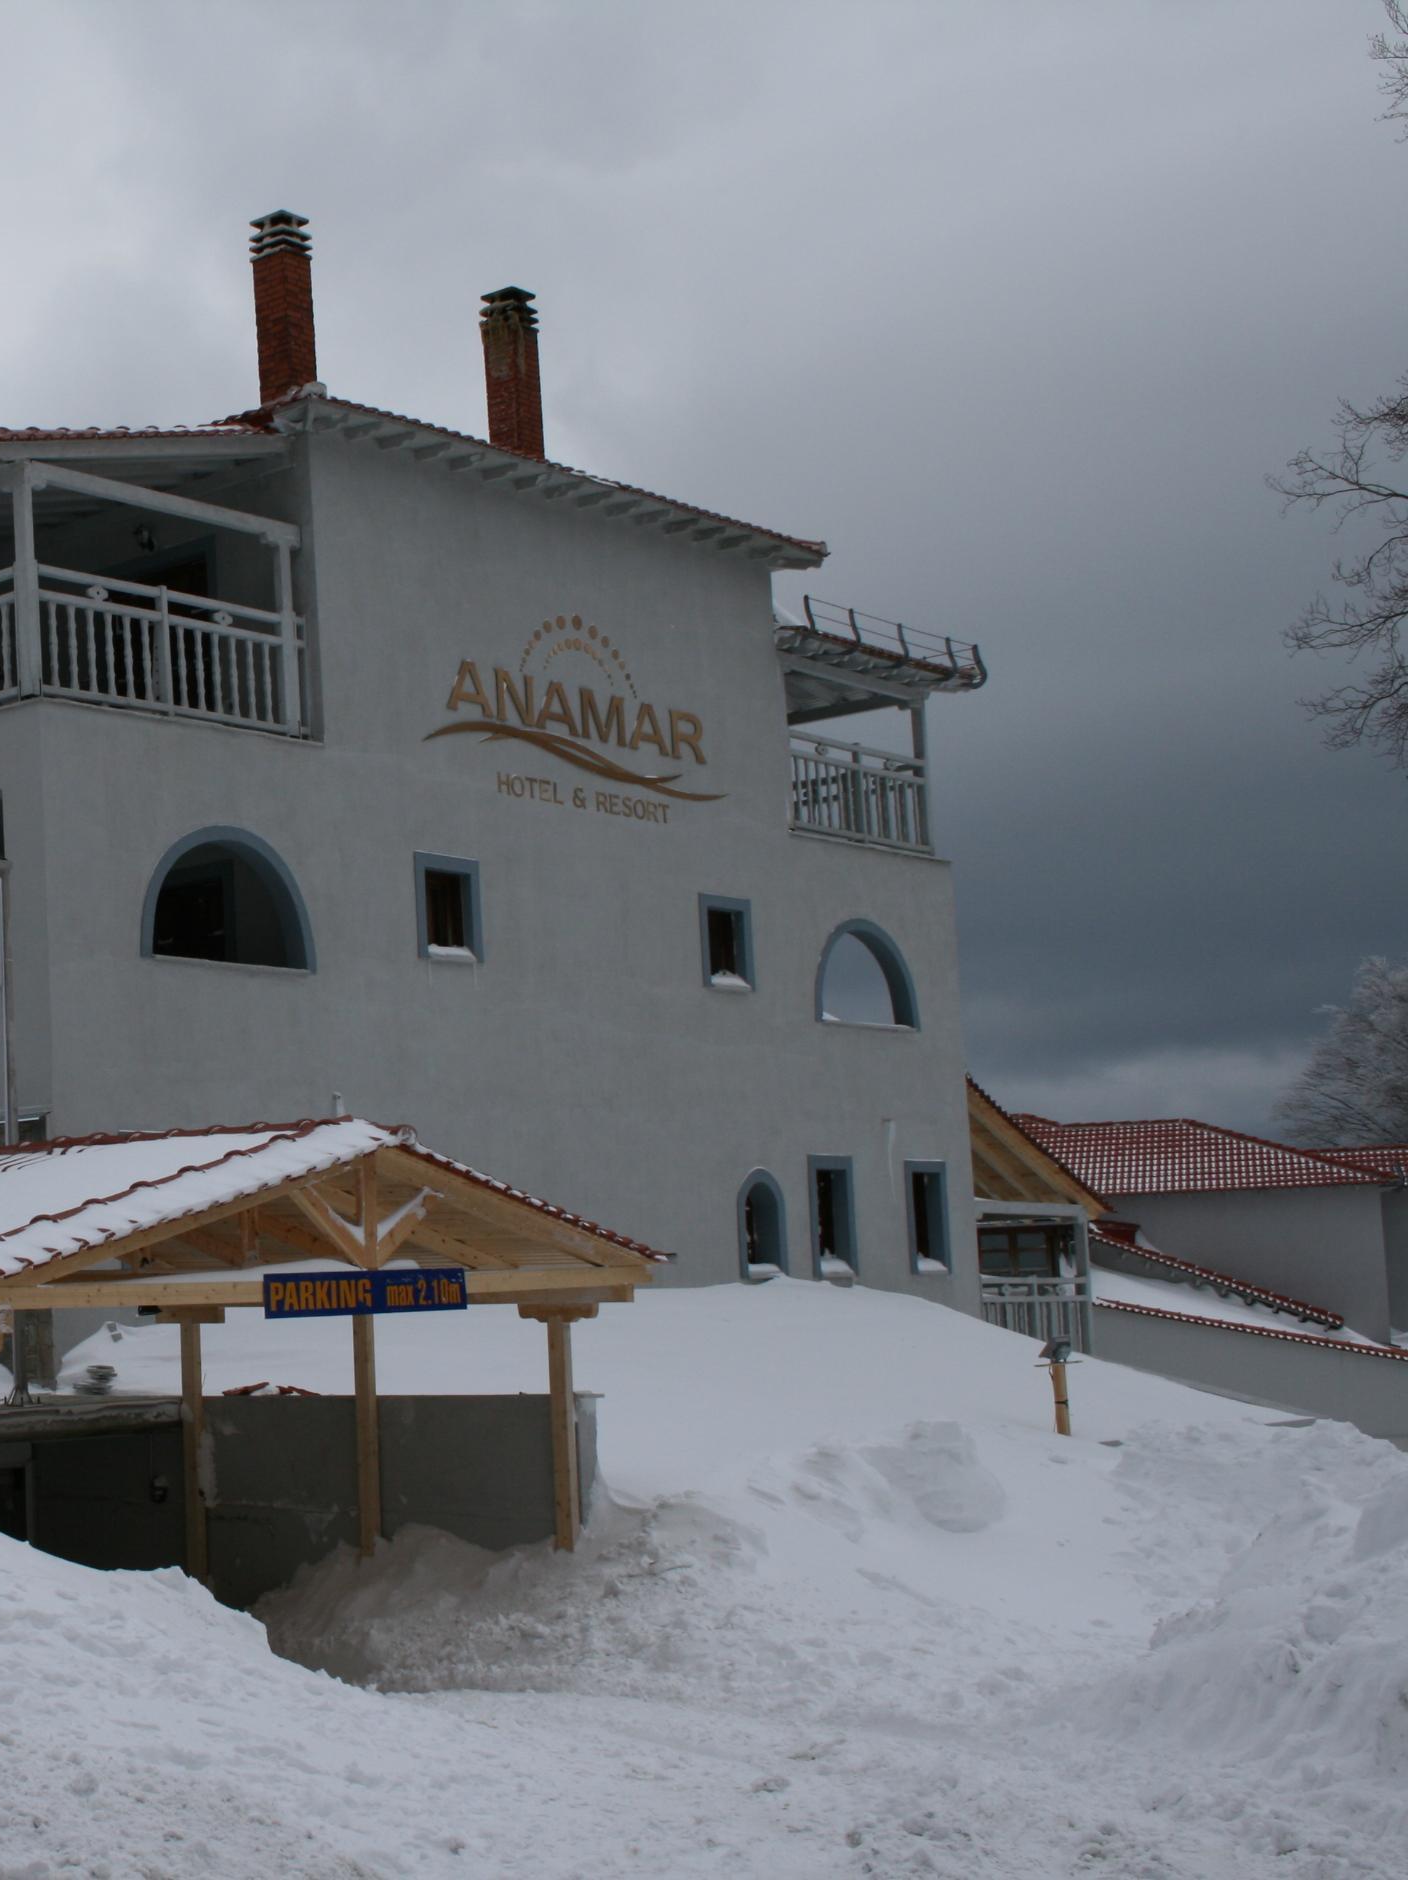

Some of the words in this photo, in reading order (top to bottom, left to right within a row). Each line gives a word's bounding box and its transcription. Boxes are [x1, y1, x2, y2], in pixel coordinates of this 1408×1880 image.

[446, 659, 706, 765] ANAMAR
[496, 772, 563, 805] HOTEL
[571, 788, 587, 809] &
[595, 792, 669, 824] RESORT
[270, 1279, 372, 1312] PARKING
[387, 1284, 414, 1307] max
